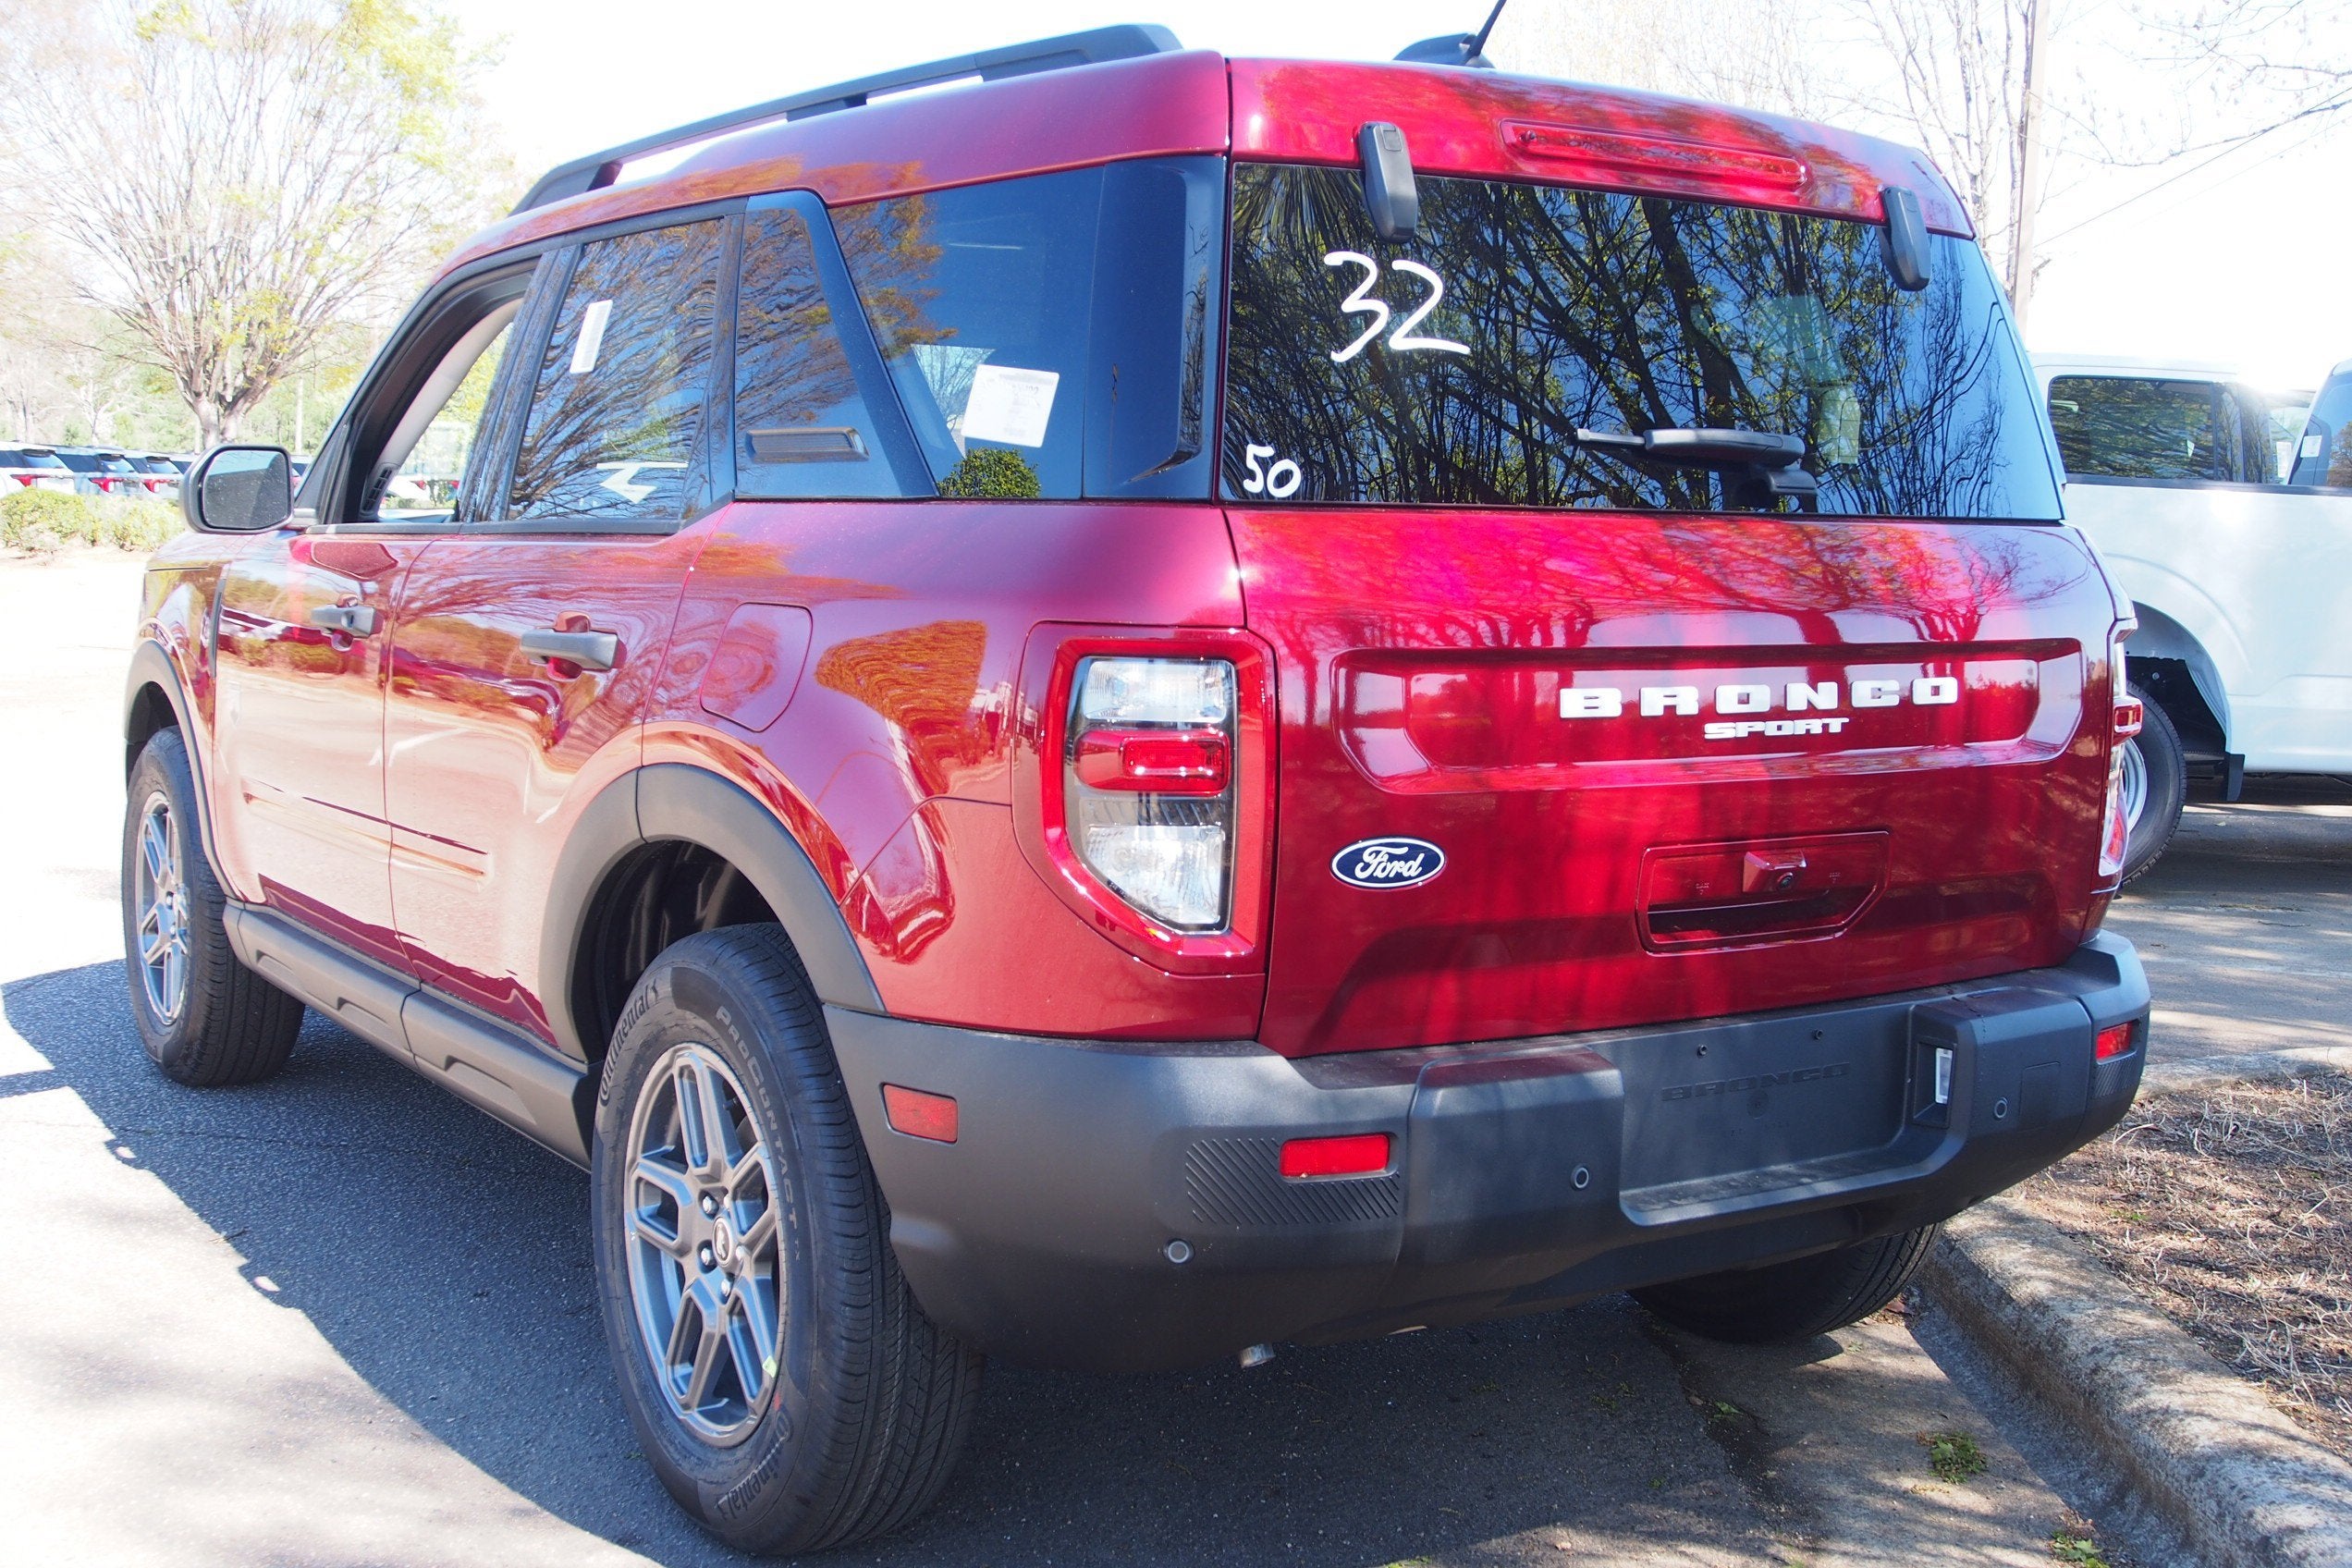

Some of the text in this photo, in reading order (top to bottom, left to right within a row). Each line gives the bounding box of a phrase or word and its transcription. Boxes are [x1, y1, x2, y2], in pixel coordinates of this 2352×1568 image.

[1324, 251, 1471, 363] 32
[1243, 444, 1302, 498] 50
[1560, 677, 1958, 718] BRONCO
[1704, 717, 1849, 740] SPORT
[1354, 846, 1425, 879] Ford
[1661, 1062, 1851, 1102] BRONCO
